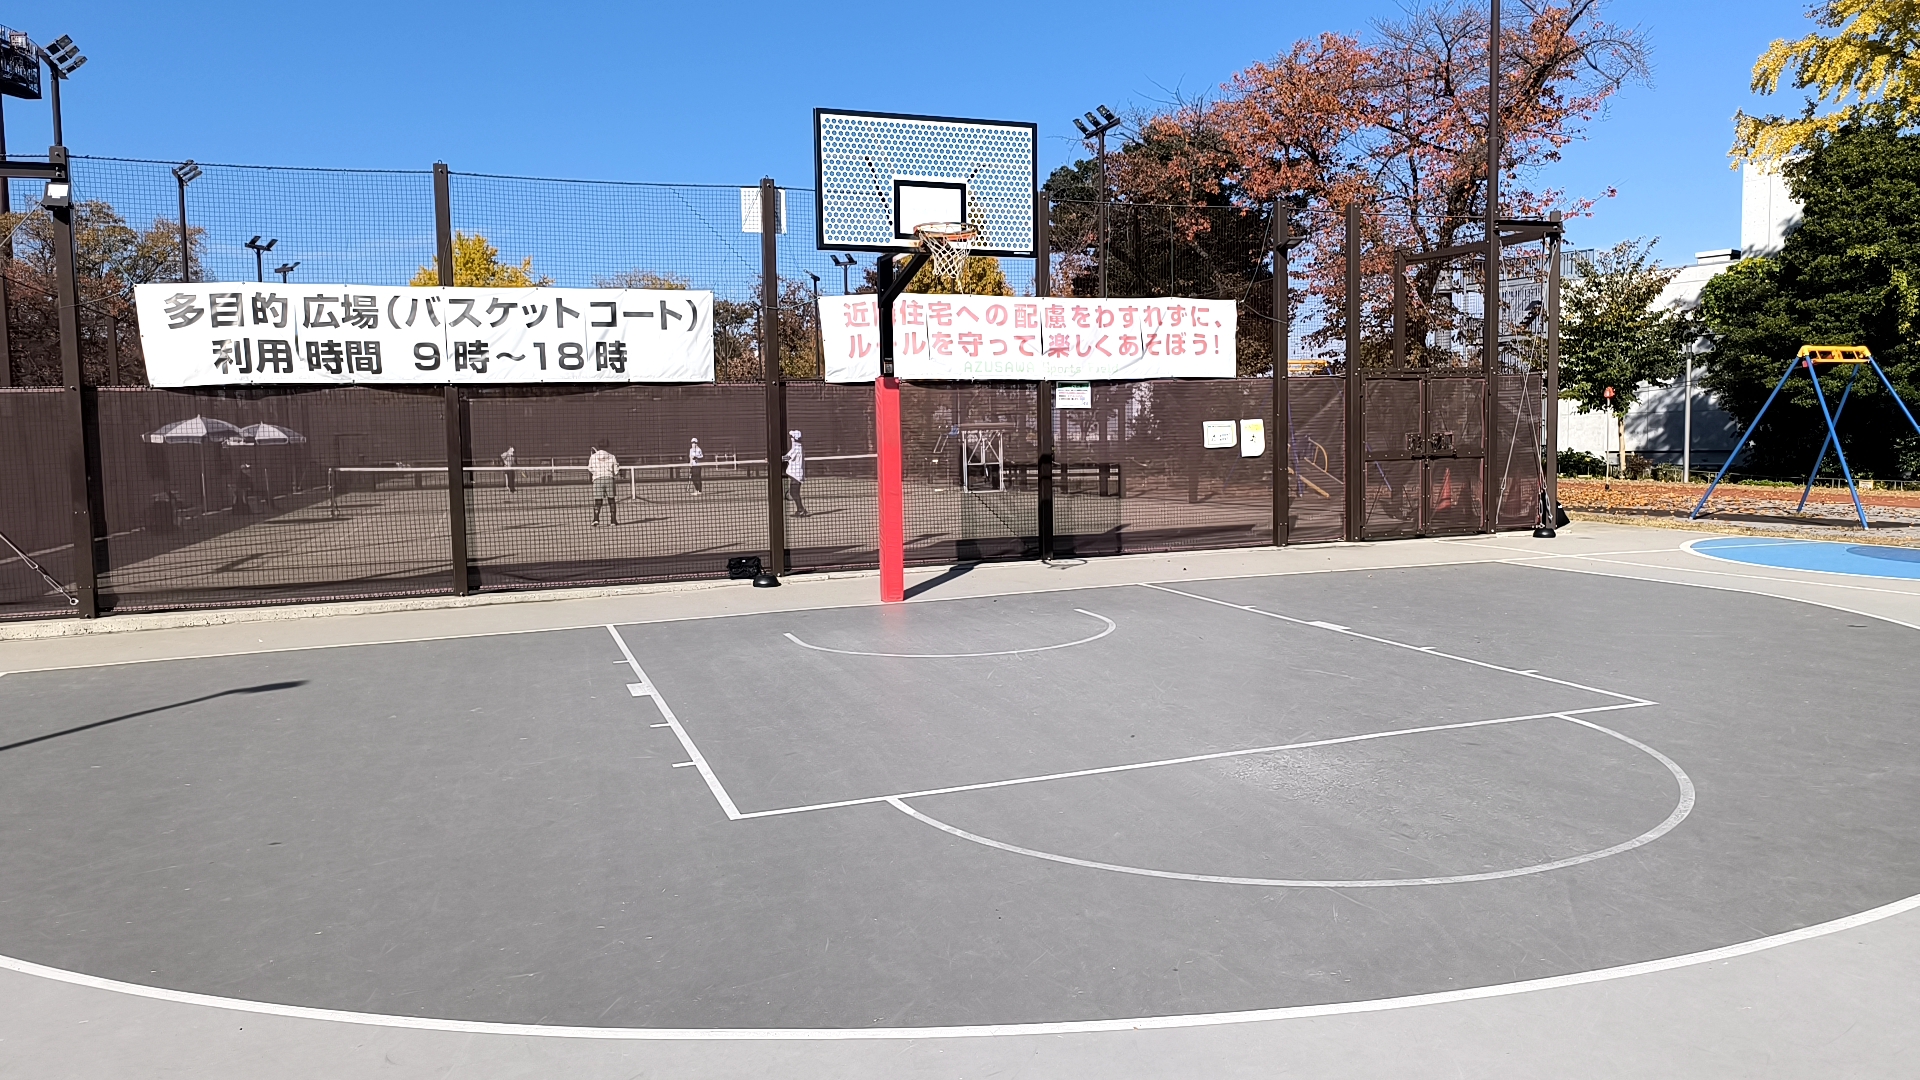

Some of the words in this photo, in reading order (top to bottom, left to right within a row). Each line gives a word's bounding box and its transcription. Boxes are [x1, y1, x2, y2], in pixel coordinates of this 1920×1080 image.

[212, 338, 383, 375] 利用時間
[848, 331, 1220, 359] ルルを守って楽しくあそぼう！
[964, 361, 1035, 373] AZUSAWA
